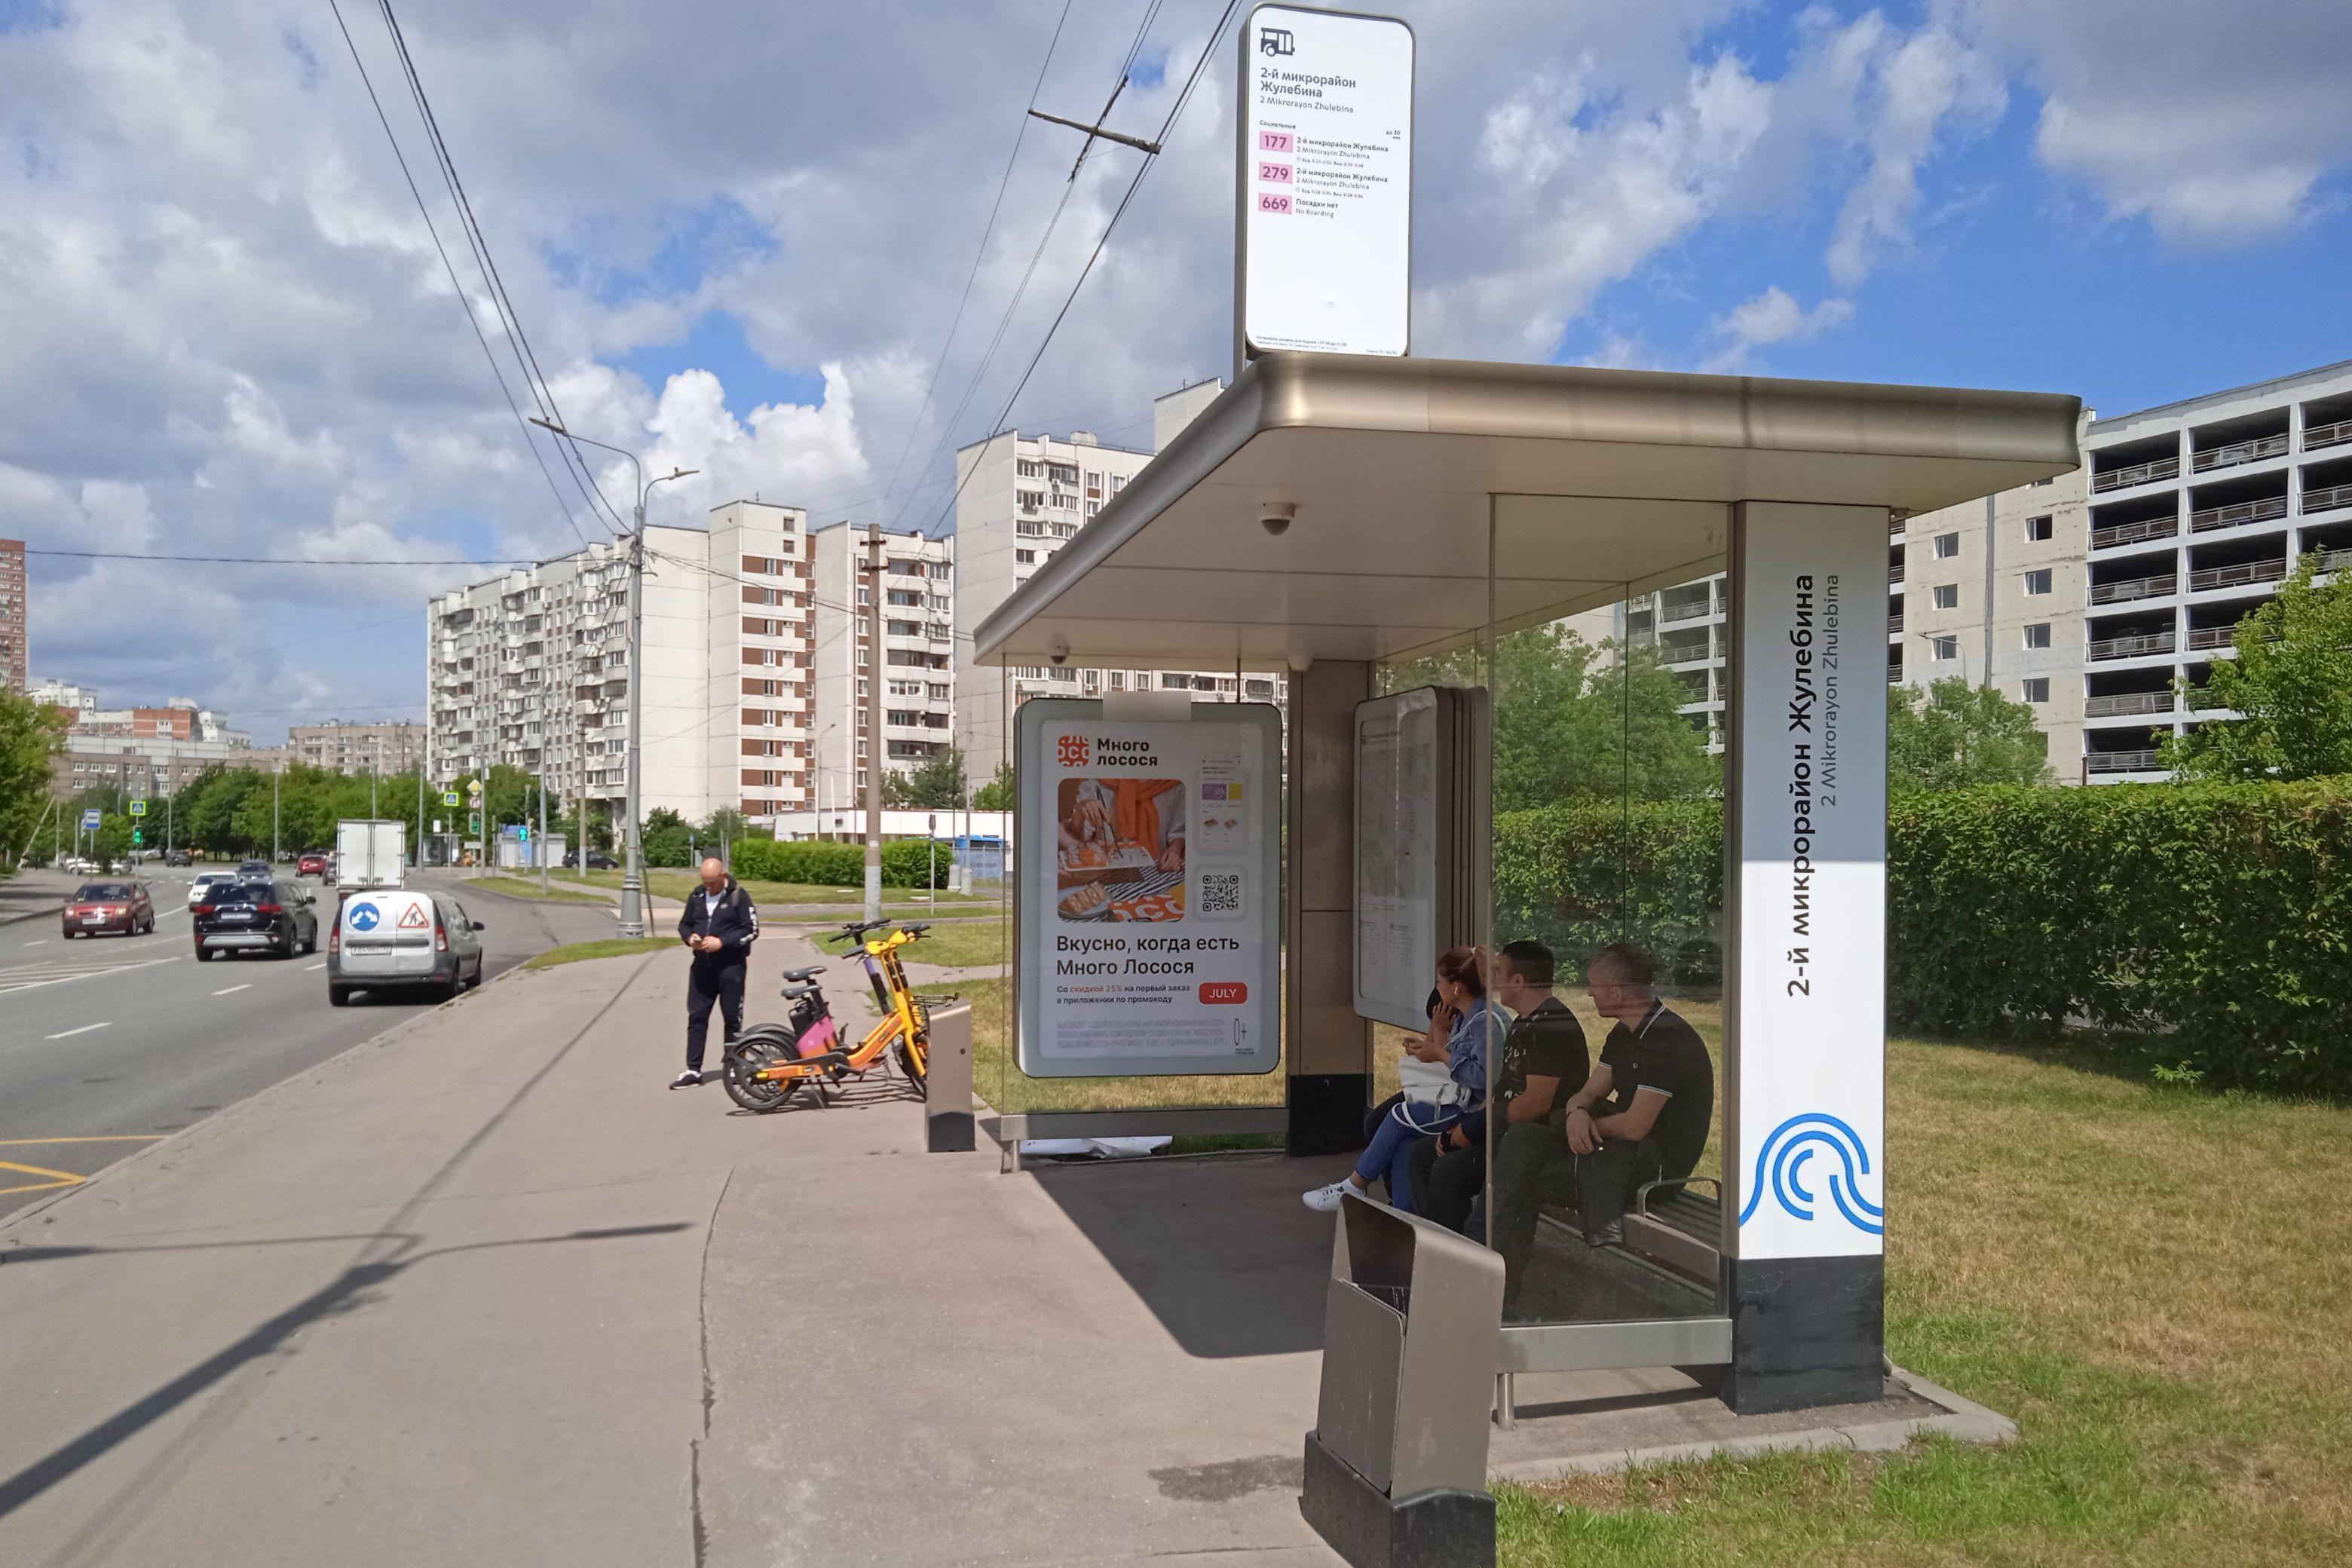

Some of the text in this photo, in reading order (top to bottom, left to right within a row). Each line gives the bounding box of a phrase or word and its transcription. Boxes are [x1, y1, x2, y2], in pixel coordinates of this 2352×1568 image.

[1260, 67, 1356, 88] 2-й микрорайон
[1260, 80, 1323, 98] Жулебина
[1266, 96, 1312, 111] Mikrorayon
[1314, 102, 1354, 114] Zhulebina
[1260, 120, 1296, 130] Социальные
[1265, 135, 1287, 149] 177
[1297, 136, 1389, 152] 2-й микрорайон Жулебина
[1302, 147, 1337, 156] Mikrorayon
[1339, 150, 1370, 159] Zhulebina
[1263, 166, 1288, 180] 279
[1296, 167, 1388, 182] 2-й микрорайон Жулебина
[1301, 178, 1337, 187] Mikrorayon
[1338, 181, 1369, 190] Zhulebina
[1263, 197, 1288, 210] 669
[1296, 198, 1325, 209] Посадки
[1306, 209, 1334, 219] Boarding
[1821, 574, 1839, 806] 2 Mikrorayon Zhulebina
[1097, 737, 1150, 752] Много
[1097, 755, 1158, 766] лосося
[1787, 574, 1817, 998] 2-й микрорайон Жулебина
[1056, 935, 1239, 954] Вкусно, когда есть
[1056, 958, 1195, 975] Много Лосося
[1056, 985, 1068, 994] Со
[1070, 985, 1104, 994] скидкой
[1106, 985, 1122, 993] 25%
[1135, 985, 1167, 994] первый
[1209, 988, 1237, 999] JULY
[1063, 997, 1114, 1006] приложении
[1127, 996, 1173, 1006] промокоду
